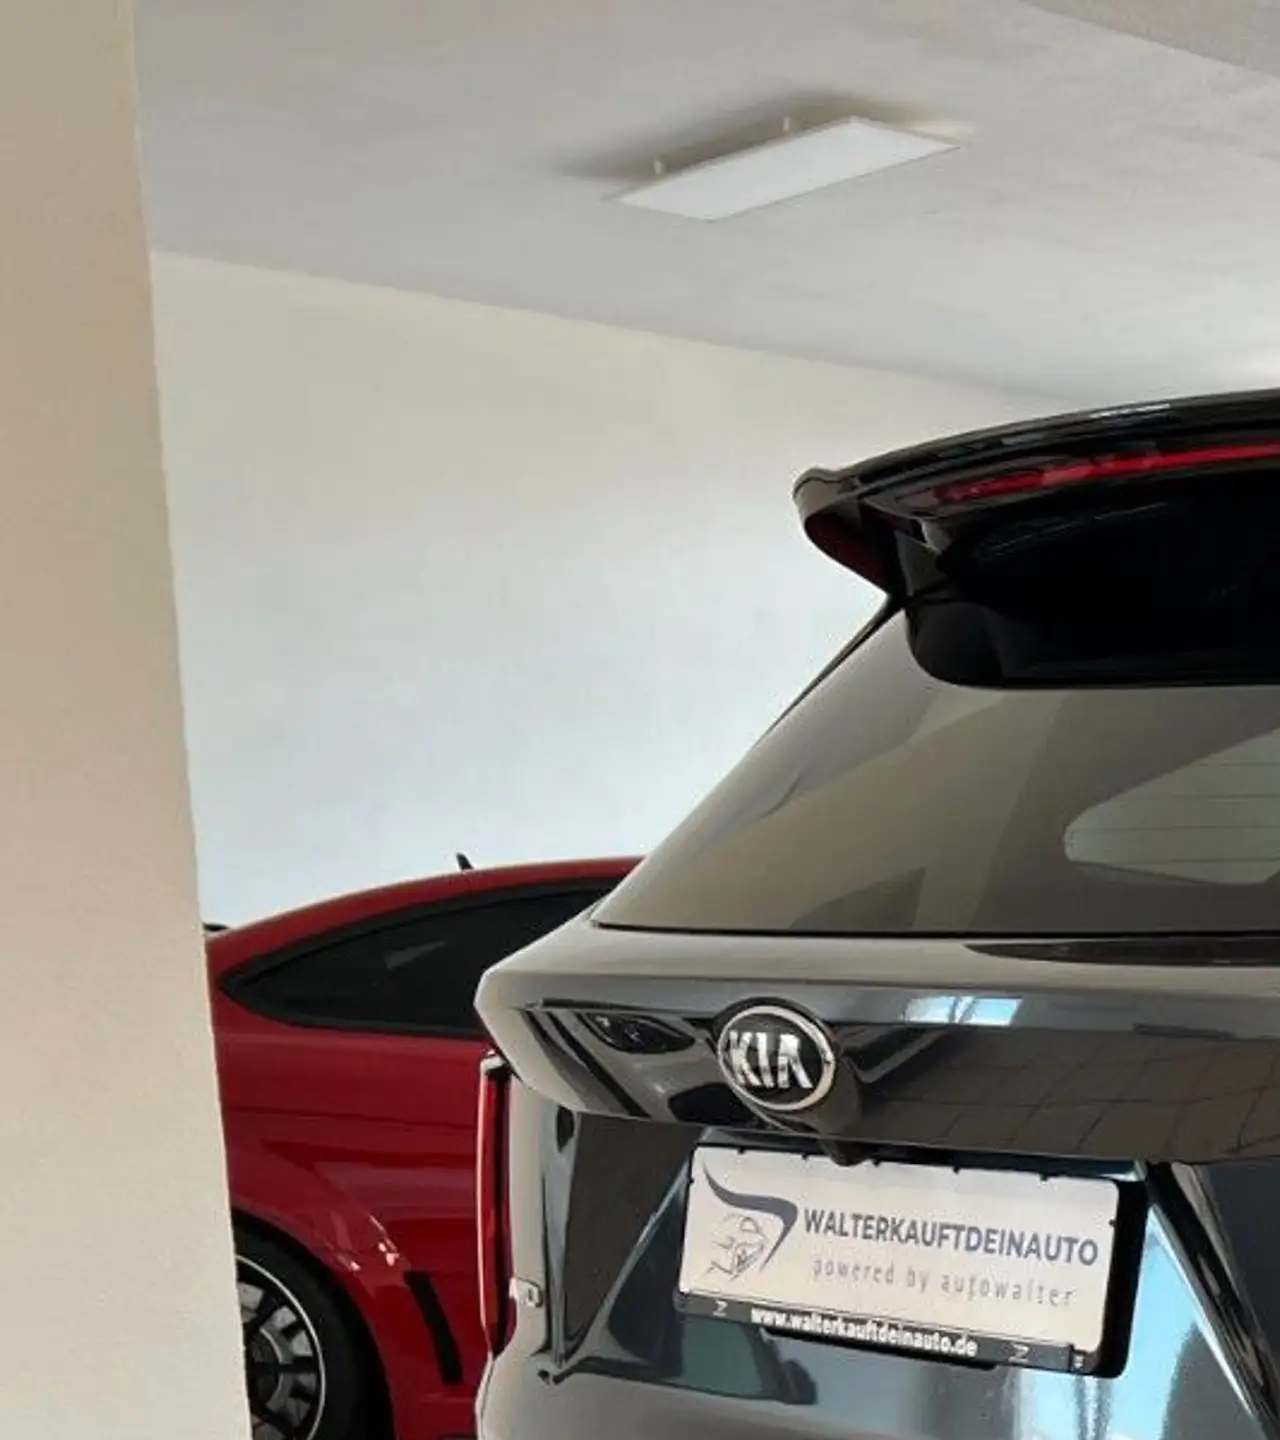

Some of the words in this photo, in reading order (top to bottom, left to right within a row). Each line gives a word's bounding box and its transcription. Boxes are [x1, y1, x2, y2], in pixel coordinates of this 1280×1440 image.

[729, 1030, 813, 1088] KIA
[804, 1207, 1099, 1266] WALTERKAUFTDEINAUTO
[813, 1258, 894, 1284] powered
[907, 1266, 929, 1292] by
[941, 1275, 1076, 1306] autowalter
[751, 1307, 978, 1357] www.walterkauftdeinauto.de
